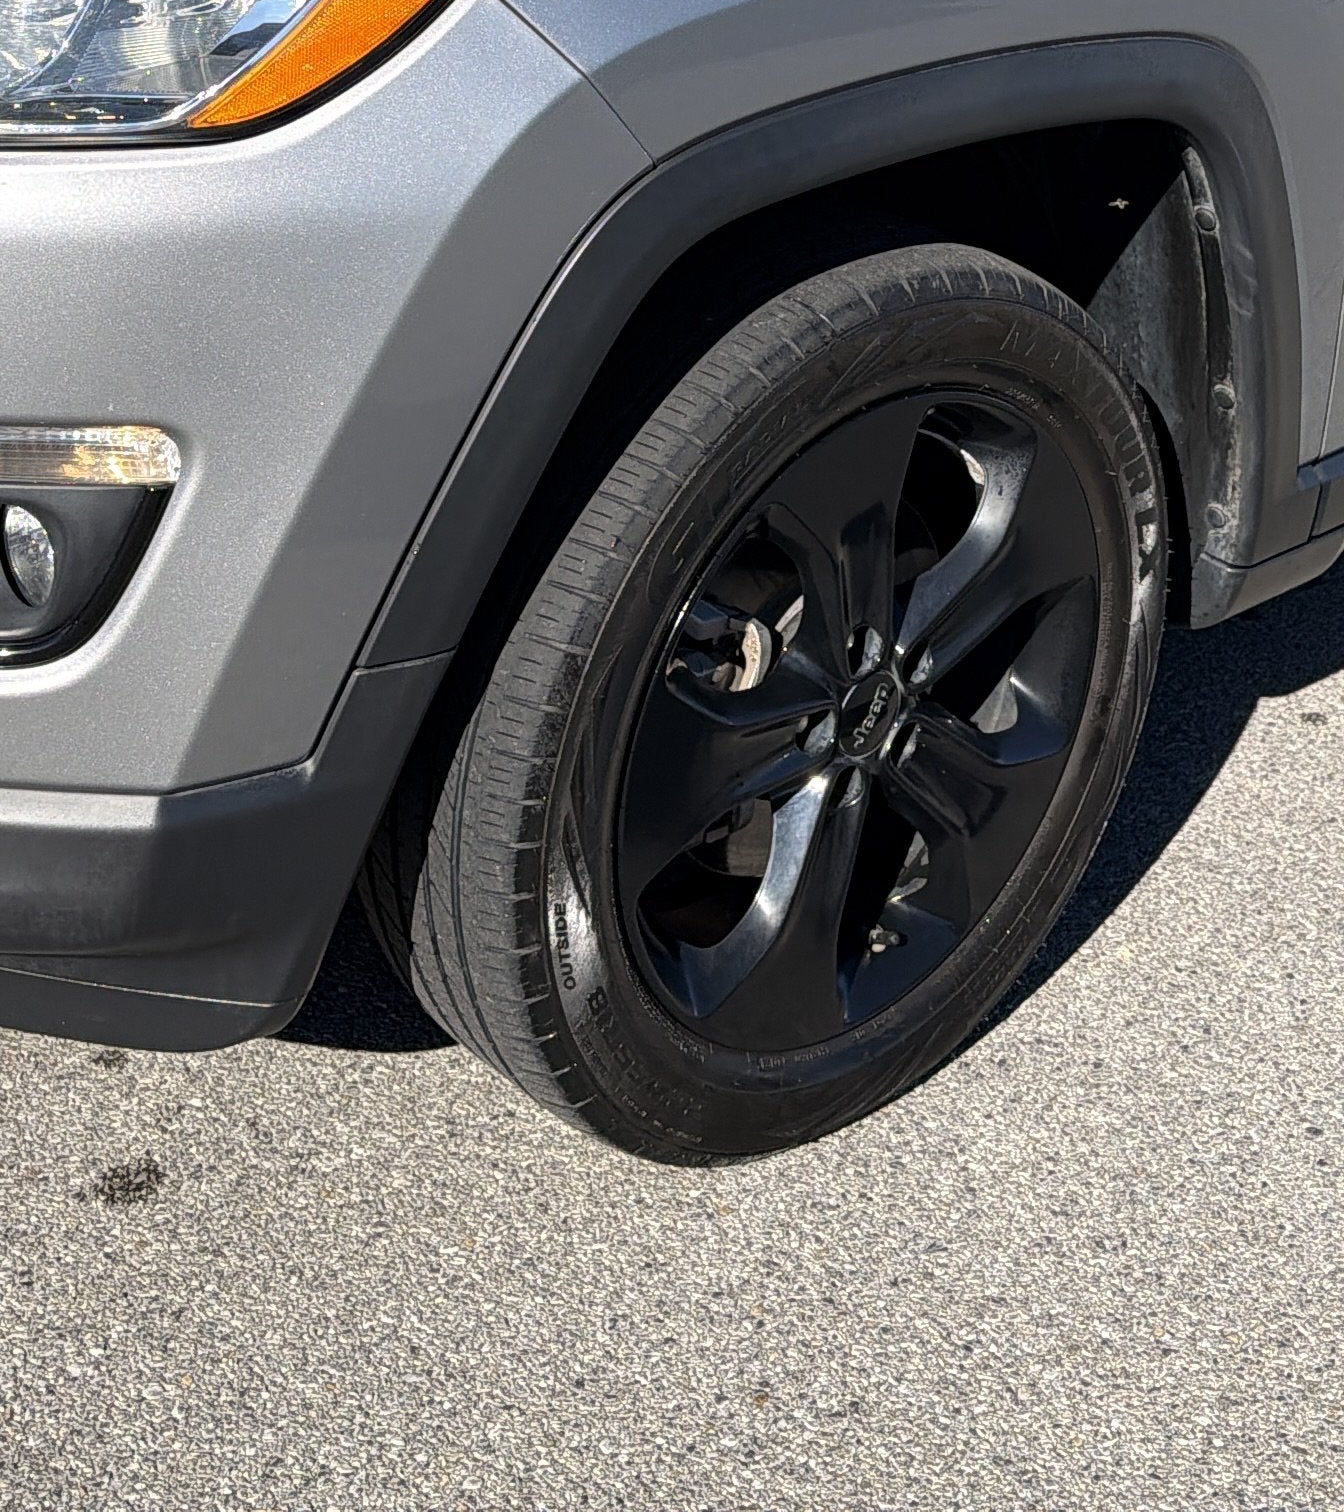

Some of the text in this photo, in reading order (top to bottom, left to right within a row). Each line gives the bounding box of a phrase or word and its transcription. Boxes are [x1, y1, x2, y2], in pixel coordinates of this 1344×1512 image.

[1134, 506, 1158, 585] LX
[853, 682, 889, 749] Jeep
[554, 902, 577, 990] OUTSIDE
